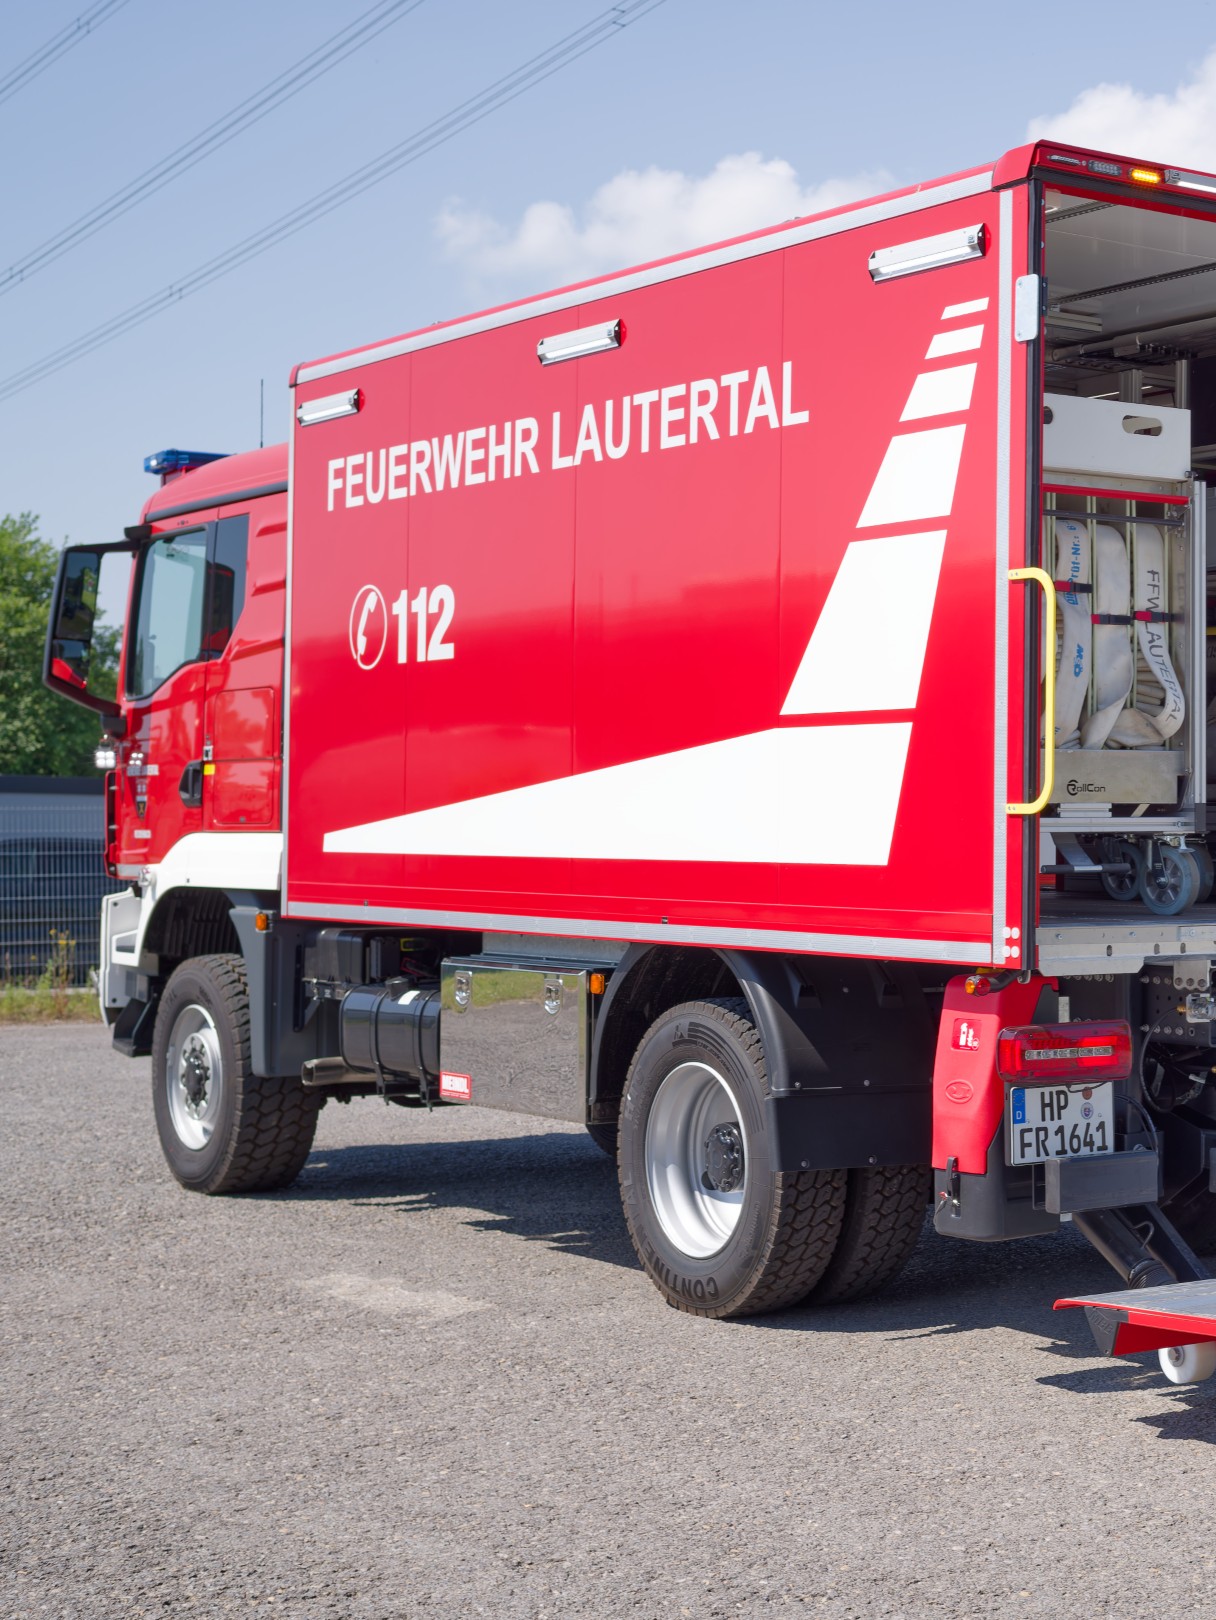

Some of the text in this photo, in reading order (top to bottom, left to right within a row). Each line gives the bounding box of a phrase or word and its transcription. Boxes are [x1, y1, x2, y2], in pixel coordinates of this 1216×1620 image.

[327, 361, 809, 512] FEUERWEHR LAUTERTAL
[392, 584, 455, 664] 112
[1016, 1110, 1022, 1120] D
[1040, 1090, 1068, 1121] HP
[1020, 1121, 1109, 1159] FR 1641
